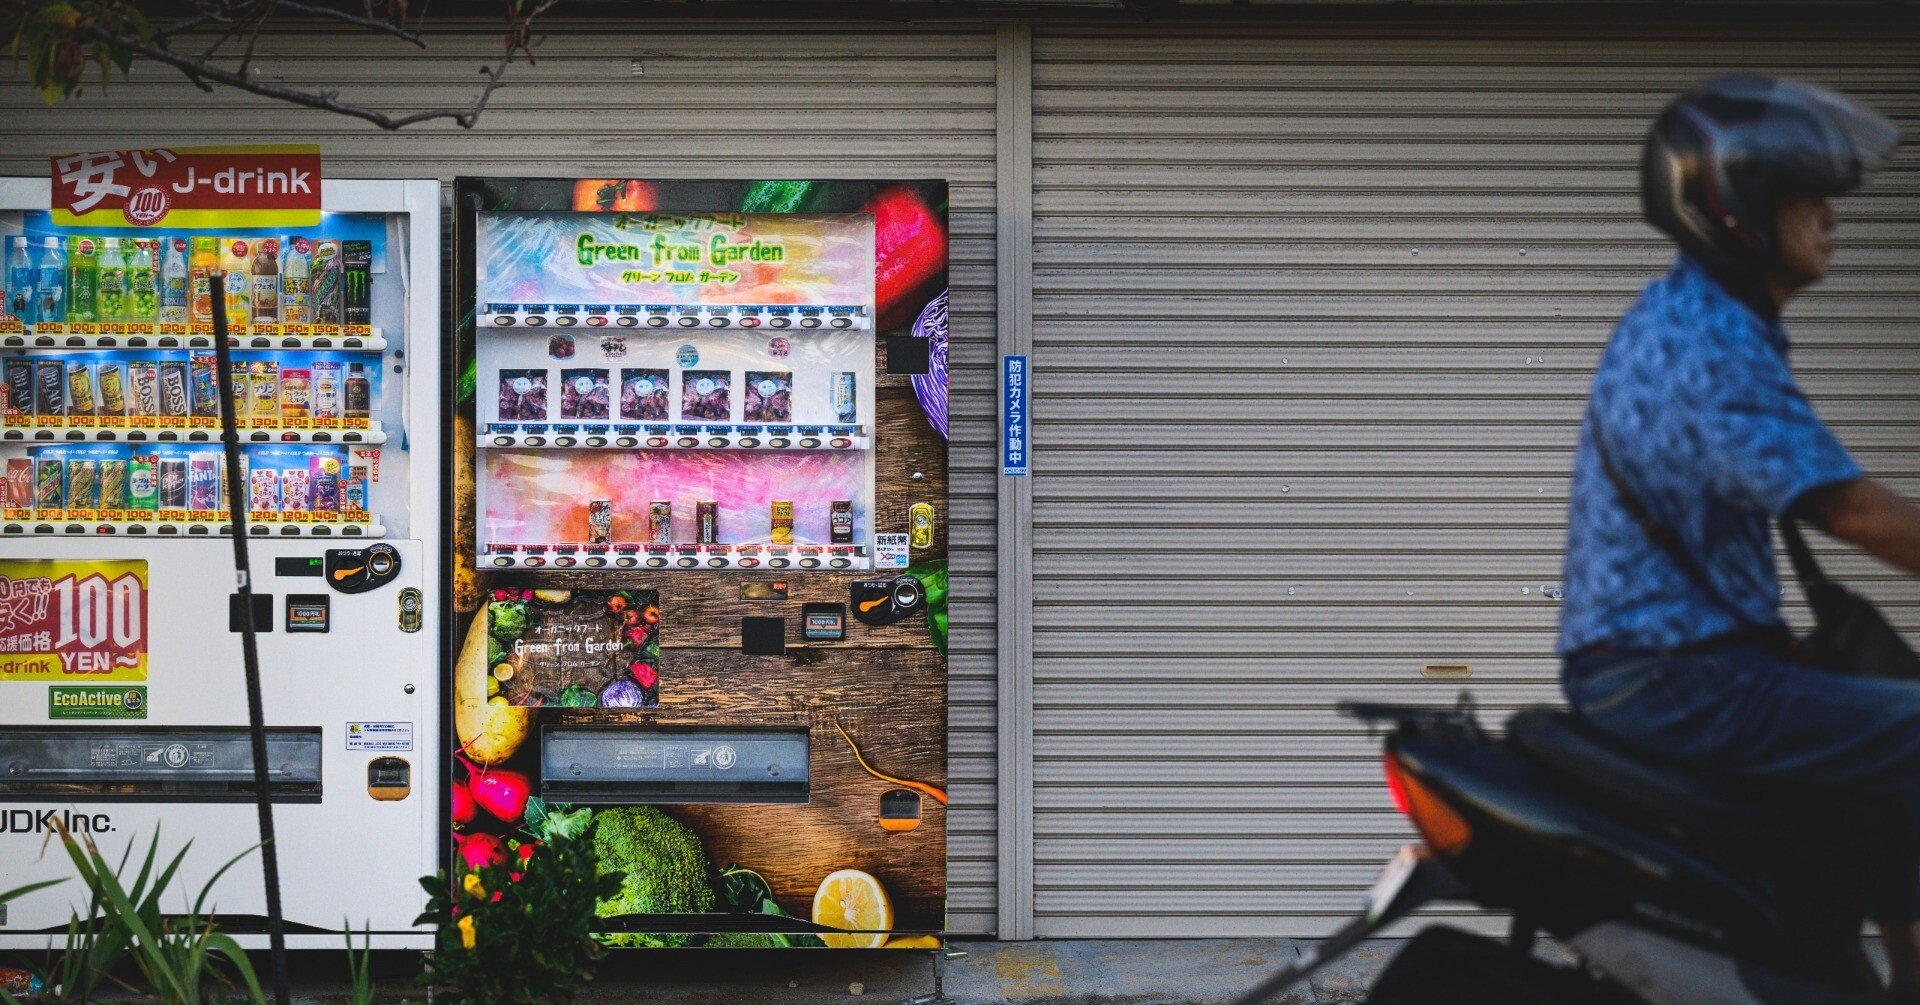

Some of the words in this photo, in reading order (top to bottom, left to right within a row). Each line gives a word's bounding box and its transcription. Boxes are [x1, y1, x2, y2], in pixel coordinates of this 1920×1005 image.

[57, 149, 177, 212] 安い
[172, 167, 312, 194] J-drink
[134, 192, 162, 213] 100
[577, 234, 640, 266] Green
[650, 234, 701, 265] from
[709, 234, 783, 266] Garden
[622, 271, 661, 283] グリーン
[665, 272, 695, 283] フロム
[699, 271, 740, 283] ガーデン
[0, 323, 22, 331] 00円
[44, 369, 62, 414] BLACK
[137, 375, 155, 413] BOSS
[167, 374, 185, 413] BOSS
[1009, 360, 1022, 464] 防犯カメラ作動中
[876, 535, 908, 546] 新紙幣
[54, 574, 141, 650] 100
[514, 638, 550, 656] Green
[553, 637, 580, 655] from
[585, 637, 623, 654] Garden
[53, 690, 122, 707] EcoActive
